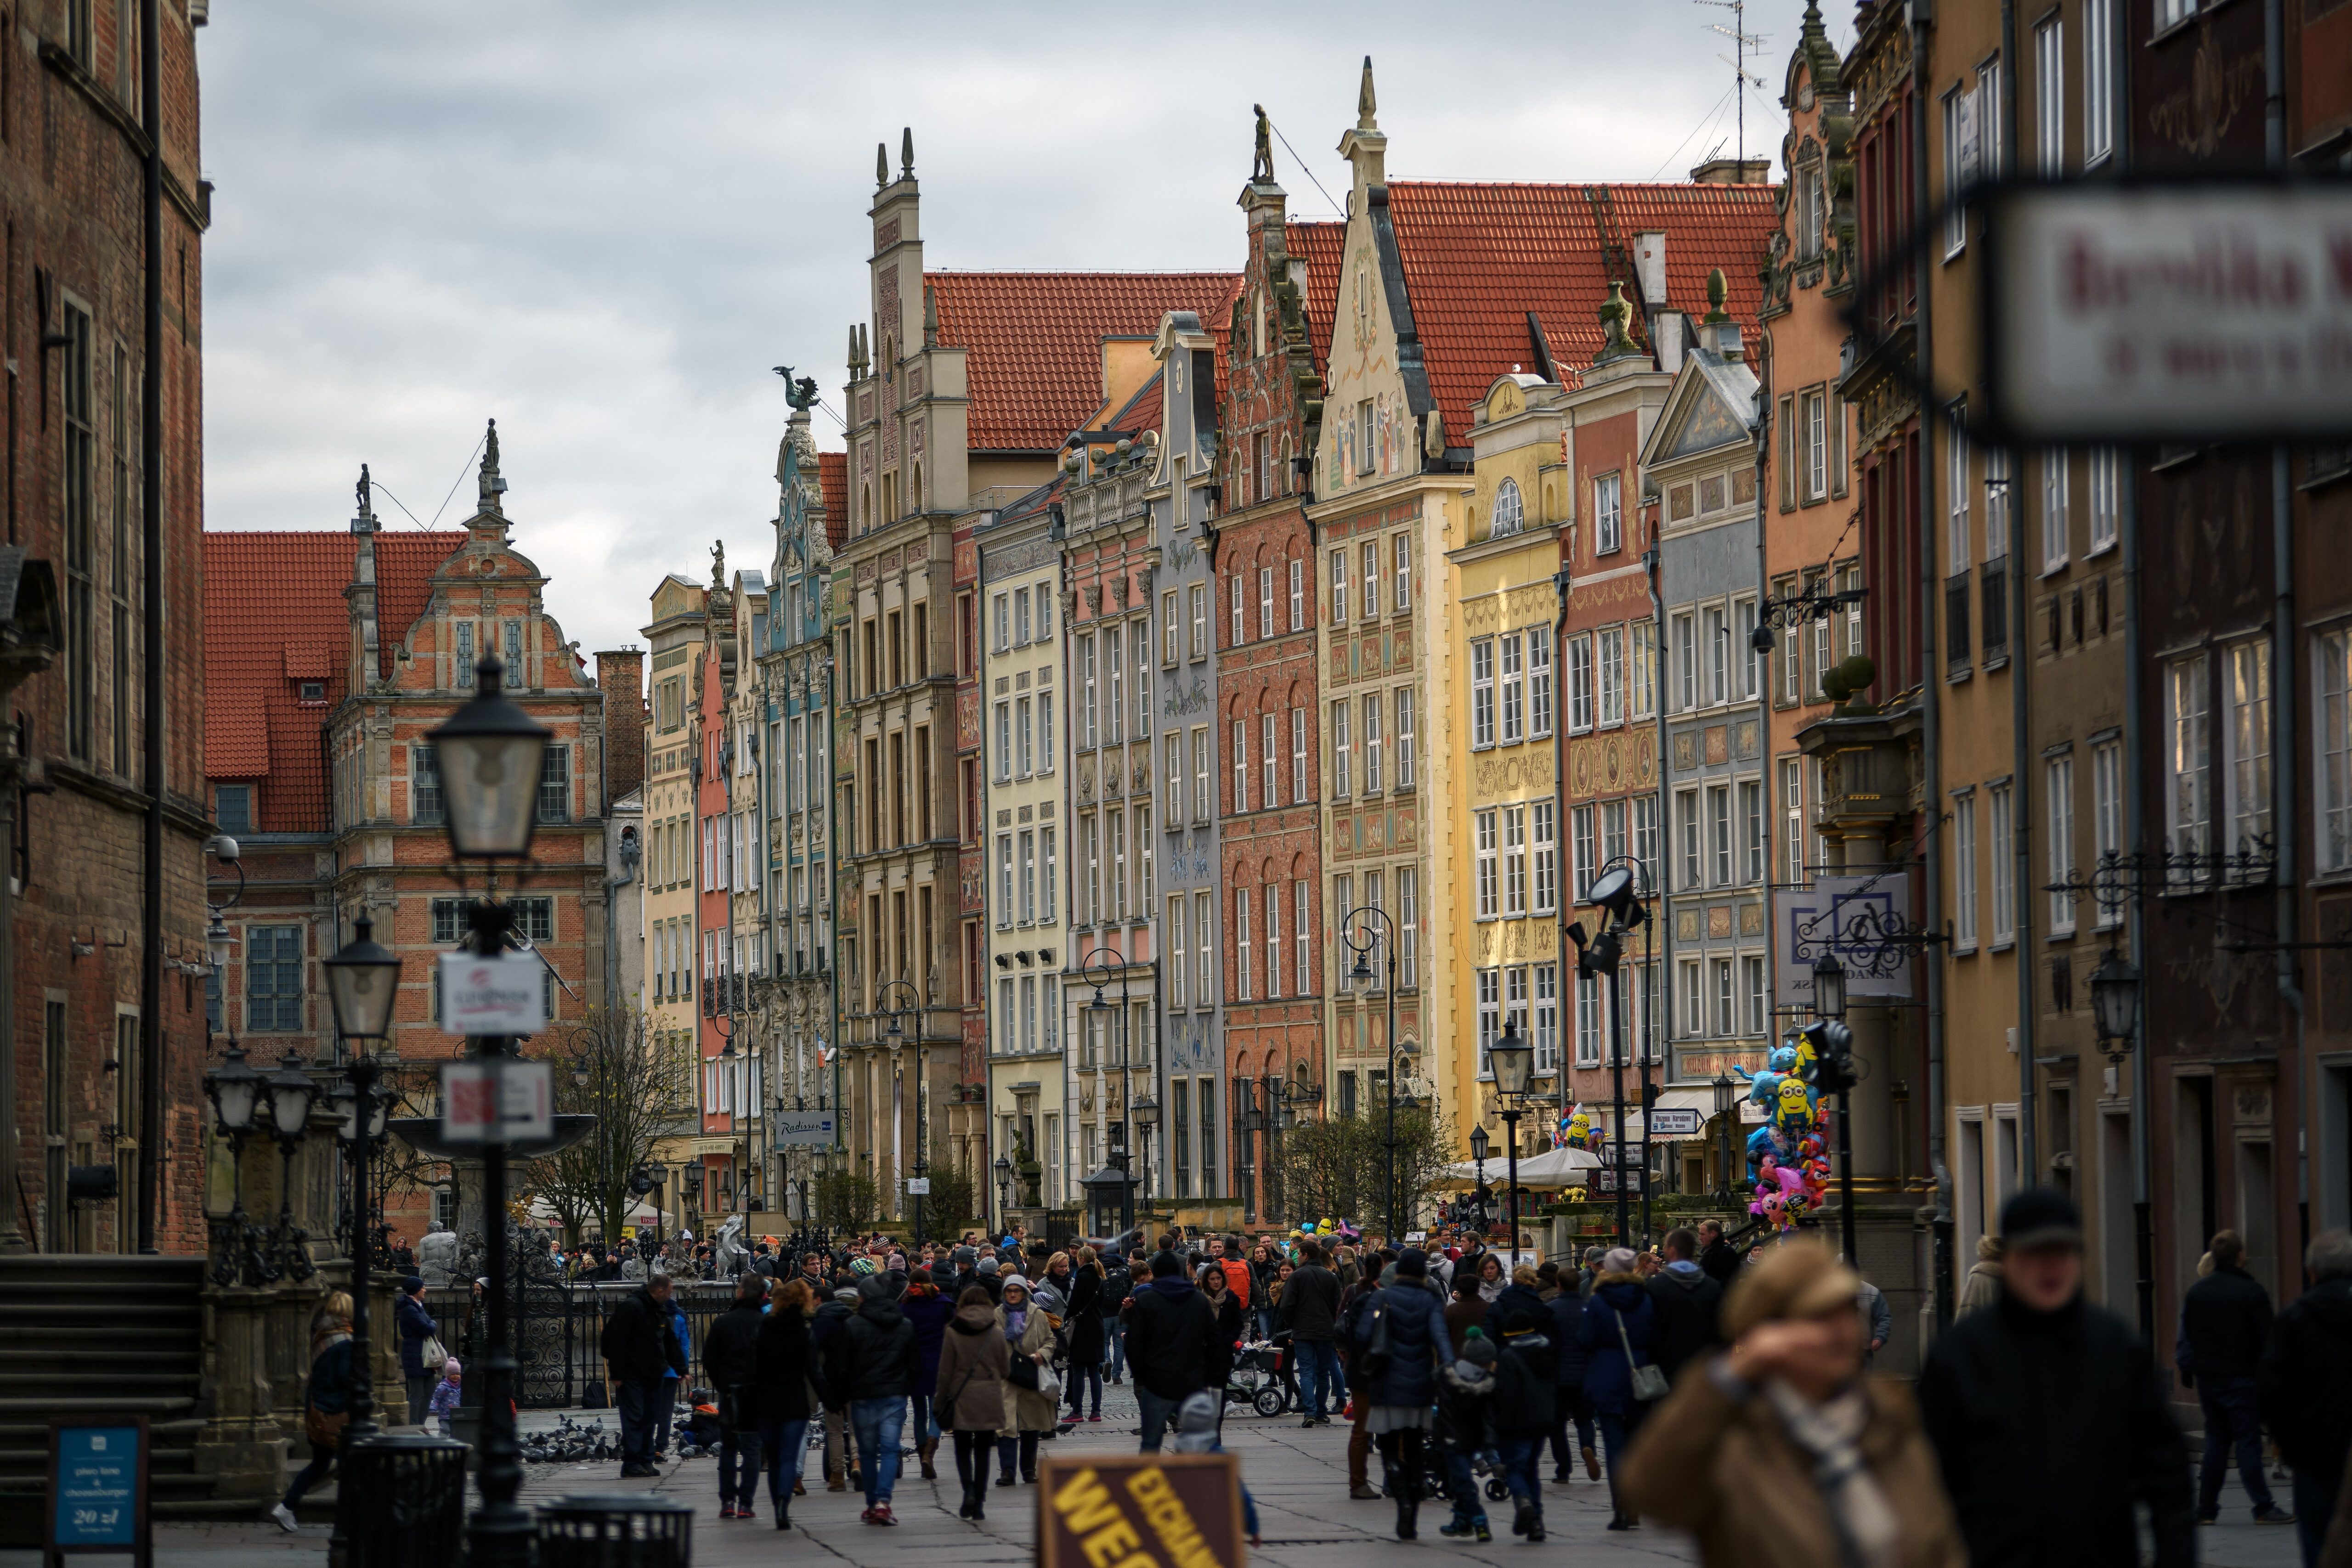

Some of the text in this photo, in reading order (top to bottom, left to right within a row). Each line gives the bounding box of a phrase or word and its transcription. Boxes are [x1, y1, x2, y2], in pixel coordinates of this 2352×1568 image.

[1687, 1056, 1720, 1073] KUCHNIA
[781, 1121, 821, 1136] Radisson
[73, 1509, 97, 1524] 20
